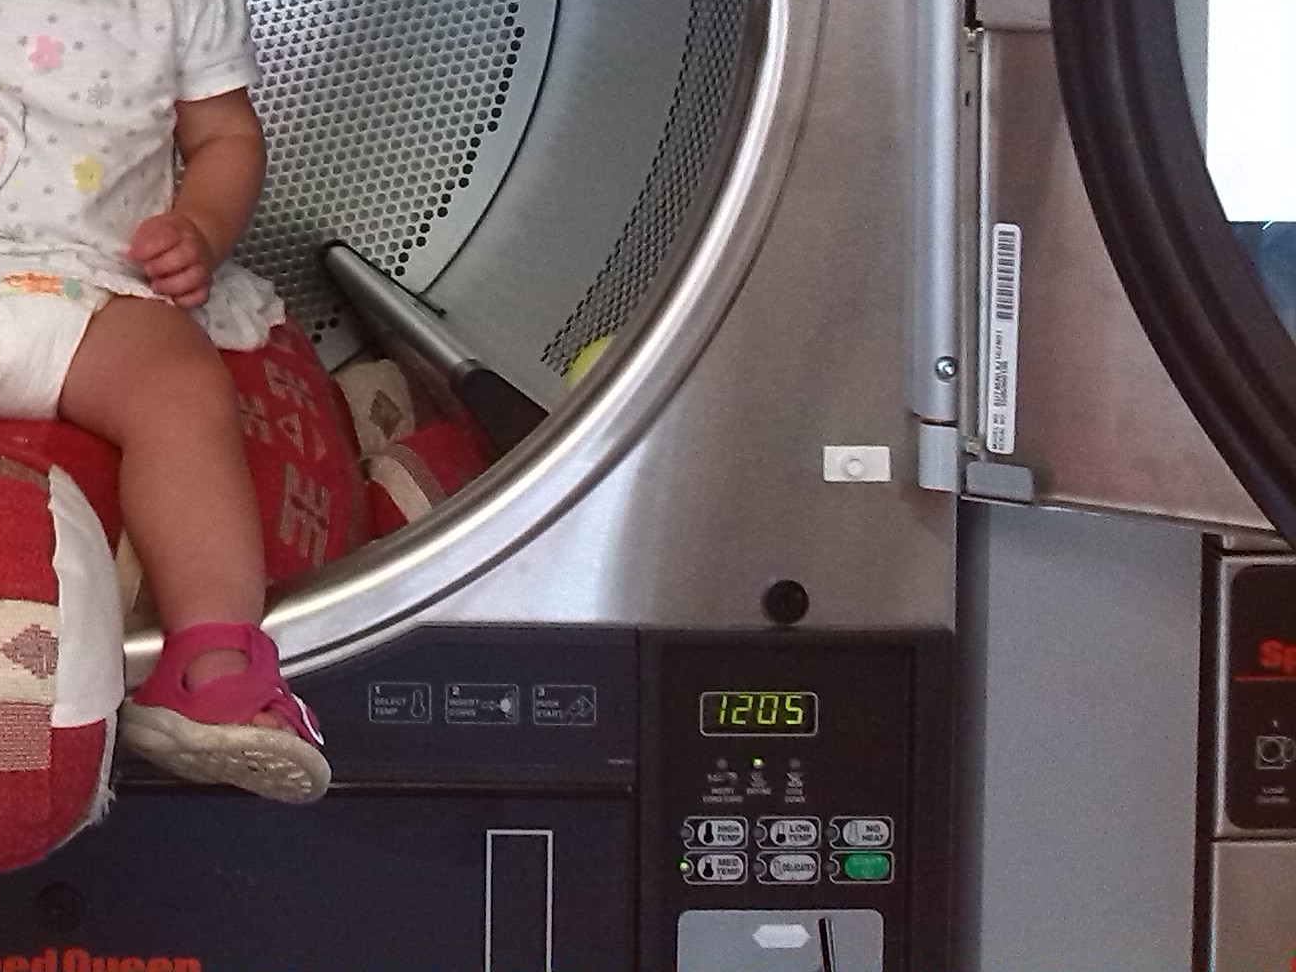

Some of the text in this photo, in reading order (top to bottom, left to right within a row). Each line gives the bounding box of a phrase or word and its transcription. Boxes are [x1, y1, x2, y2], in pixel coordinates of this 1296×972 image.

[719, 694, 804, 725] 1205
[788, 824, 812, 833] LOW
[866, 825, 881, 833] NO
